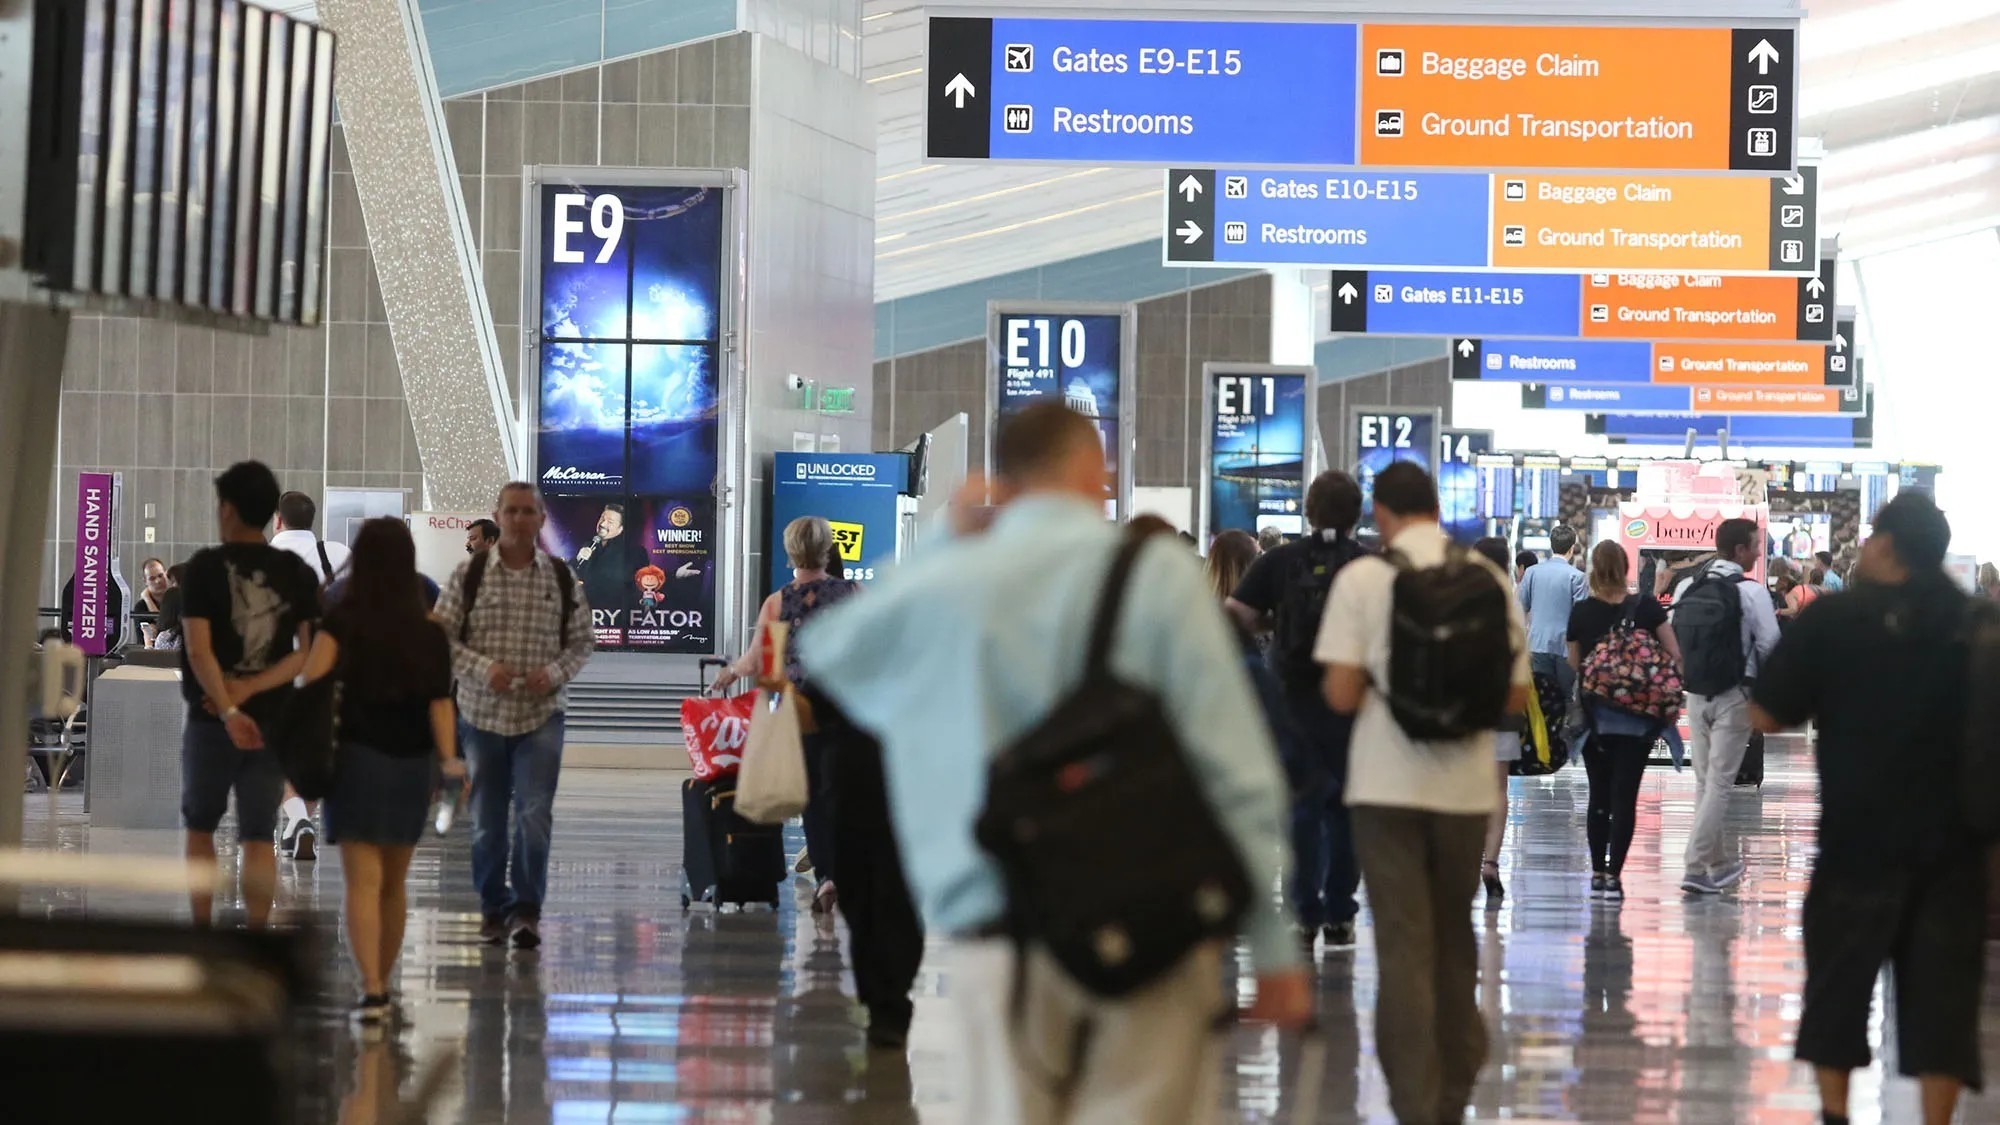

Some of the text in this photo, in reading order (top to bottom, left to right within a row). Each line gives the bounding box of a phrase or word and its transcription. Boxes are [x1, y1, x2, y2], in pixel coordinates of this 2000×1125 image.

[1052, 46, 1242, 75] Gates E9-E15
[1422, 52, 1599, 80] Baggage Claim
[1053, 107, 1194, 135] Restrooms
[1421, 113, 1693, 141] Ground Transportation
[1261, 178, 1418, 200] Gates E10-E15
[1538, 183, 1671, 204] Baggage Claim
[553, 193, 624, 264] E9
[1261, 224, 1367, 246] Restrooms
[1538, 228, 1742, 250] Ground Transportation
[1618, 274, 1722, 289] Baggage Claim
[1401, 286, 1524, 304] Gates E11-E15
[1618, 306, 1776, 324] Ground Transportation
[1007, 319, 1086, 368] E10
[1509, 355, 1576, 371] Restrooms
[1681, 358, 1808, 373] Ground Transportation
[1007, 368, 1034, 380] Flight
[1218, 376, 1274, 415] E11
[1569, 388, 1620, 400] Restrooms
[1716, 389, 1825, 403] Ground Transportation
[1361, 416, 1412, 448] E12
[1441, 435, 1470, 463] 14
[542, 465, 623, 480] McCarran
[808, 463, 876, 476] UNLOCKED
[428, 516, 472, 529] ReCha
[1656, 521, 1714, 541] benefi
[657, 529, 702, 542] WINNER!
[81, 488, 101, 639] HAND SANITIZER
[630, 609, 703, 628] FATOR
